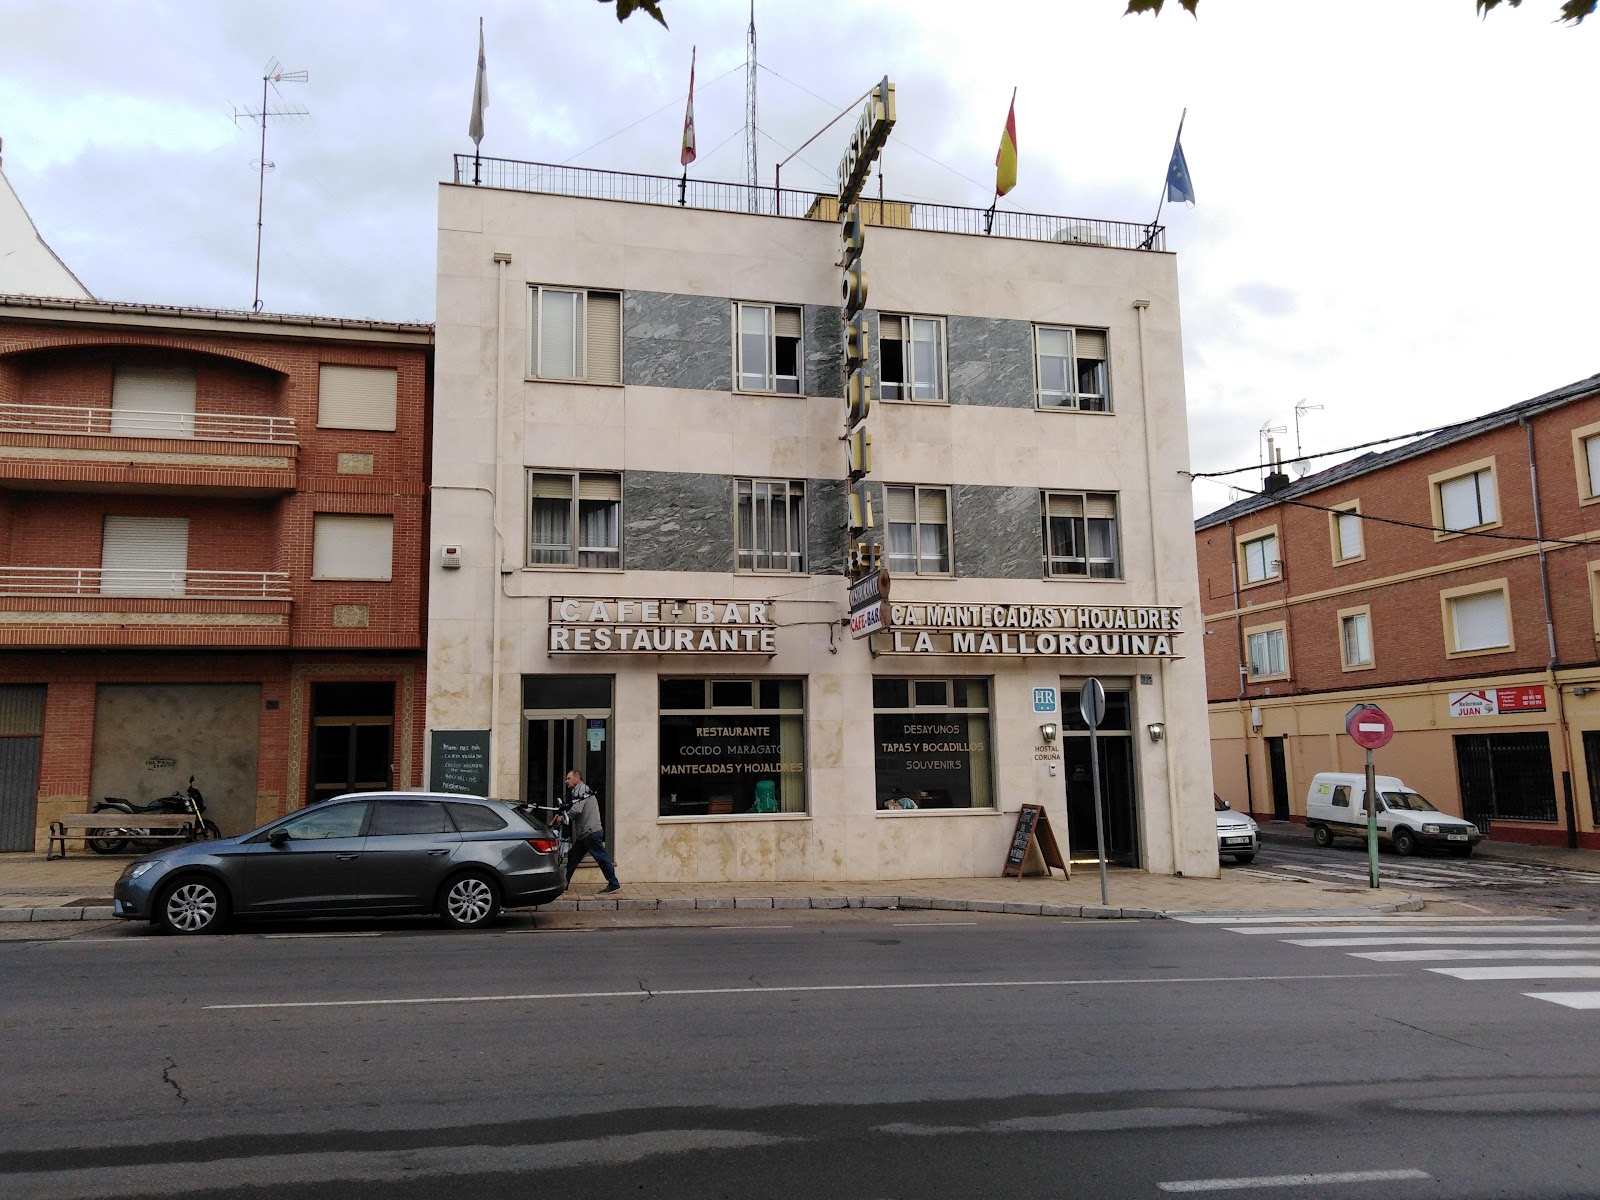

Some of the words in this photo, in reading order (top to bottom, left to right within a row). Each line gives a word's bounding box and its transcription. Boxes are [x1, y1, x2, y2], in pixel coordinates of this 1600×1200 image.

[837, 86, 888, 203] HOSTAL
[927, 605, 1055, 628] MANTECADAS
[1060, 608, 1072, 627] Y
[1078, 608, 1183, 629] HOJALDRES
[551, 628, 776, 651] RESTAURANTE
[895, 631, 934, 652] LA
[952, 633, 1171, 655] MALLORQUINA
[1458, 708, 1481, 716] JUAN
[696, 727, 770, 737] RESTAURANTE
[903, 725, 960, 735] DESAYUNOS
[679, 746, 722, 756] COCIDO
[881, 743, 912, 753] TAPAS
[913, 743, 920, 752] Y
[922, 742, 985, 752] BOCADILLOS
[1034, 753, 1061, 761] CORUÑA
[660, 763, 734, 775] MANTECADAS
[735, 764, 743, 773] Y
[744, 763, 804, 773] HOJALDRES
[905, 760, 962, 770] SOUVENIRS
